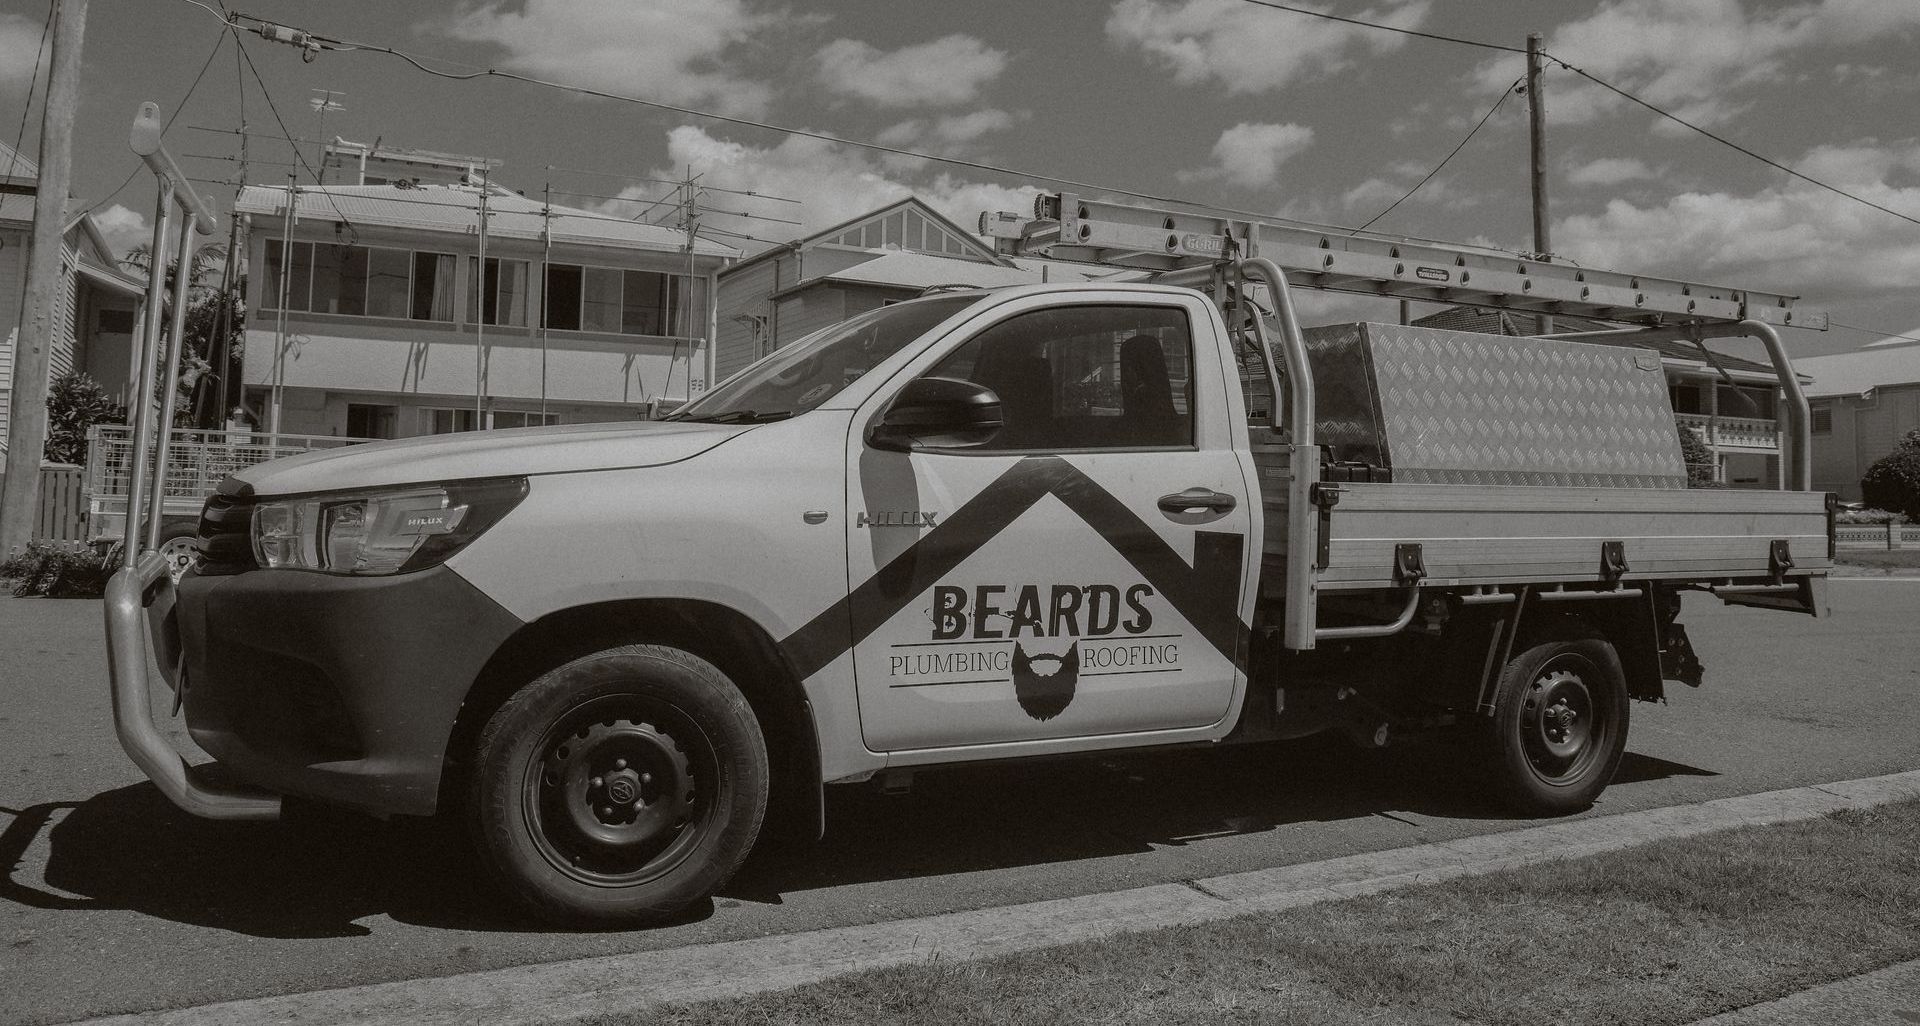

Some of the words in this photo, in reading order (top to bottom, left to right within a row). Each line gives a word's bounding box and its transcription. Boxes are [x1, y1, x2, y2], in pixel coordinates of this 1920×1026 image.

[407, 517, 443, 526] HILUX
[856, 511, 939, 529] HILUX
[931, 583, 1154, 641] BEARDS
[889, 650, 1009, 676] PLUMBING
[1083, 644, 1179, 668] ROOFING
